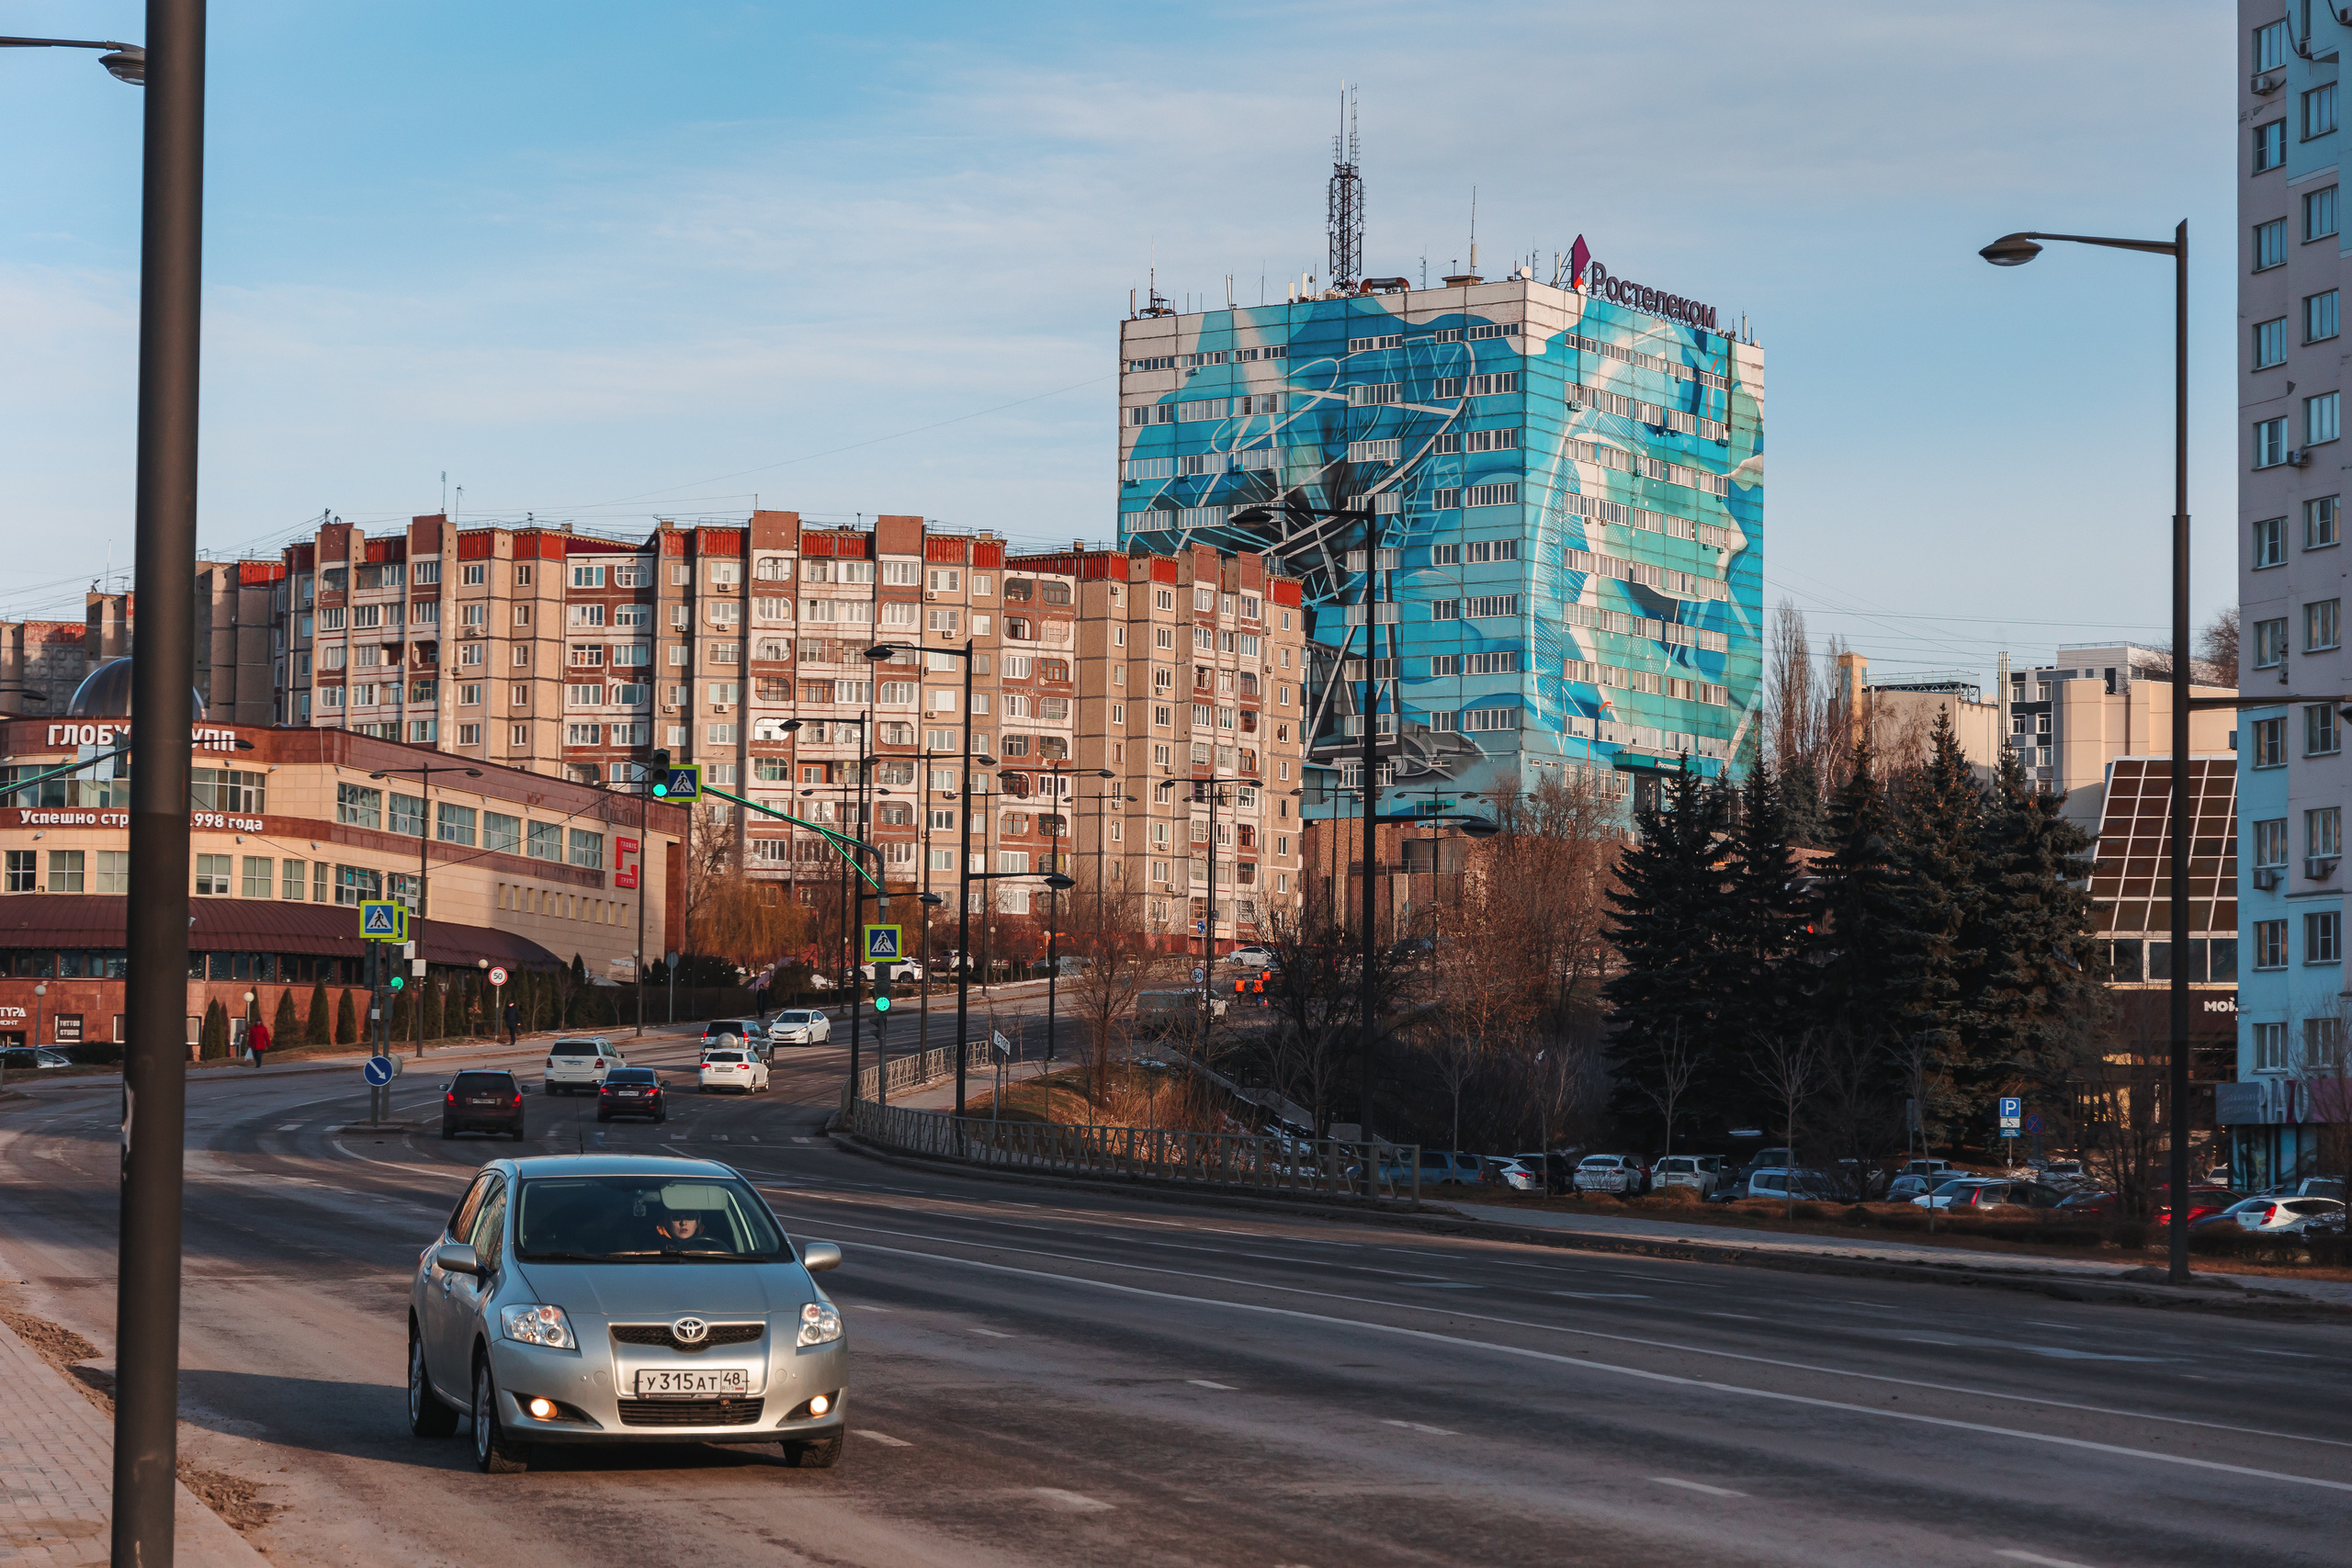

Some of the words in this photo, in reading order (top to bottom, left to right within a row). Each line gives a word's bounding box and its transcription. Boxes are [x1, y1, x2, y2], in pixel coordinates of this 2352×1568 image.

[1592, 261, 1716, 329] Ростелеком
[20, 810, 96, 825] Успешно
[100, 813, 130, 828] стр
[190, 812, 224, 828] 998
[228, 818, 263, 832] года
[492, 972, 503, 980] 50
[0, 1007, 27, 1018] ТУРА
[2006, 1100, 2017, 1115] P
[723, 1372, 741, 1385] 48
